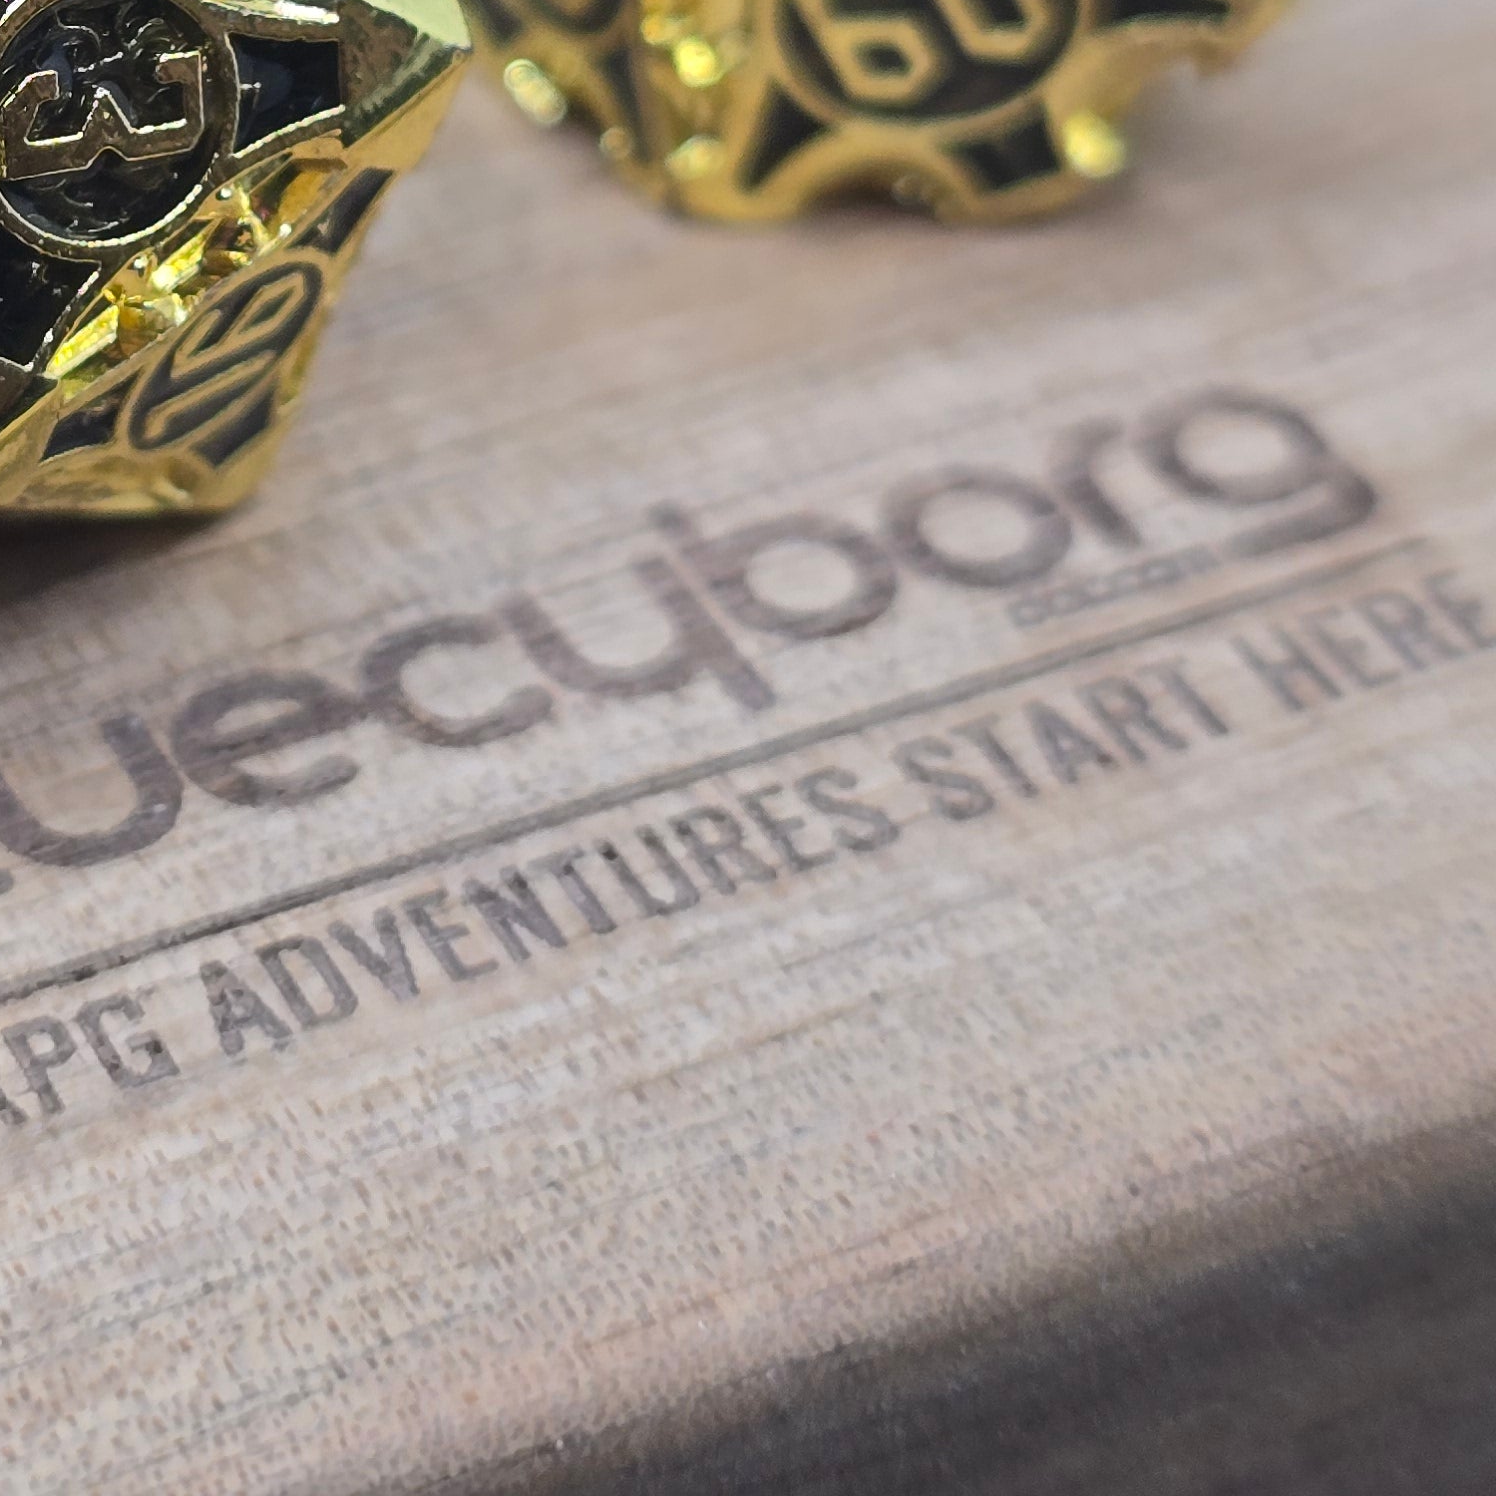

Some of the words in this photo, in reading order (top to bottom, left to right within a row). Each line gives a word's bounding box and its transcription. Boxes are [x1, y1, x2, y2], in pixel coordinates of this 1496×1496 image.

[199, 765, 901, 1061] ADVENTURES
[890, 656, 1231, 823] START
[1228, 566, 1496, 713] HERE
